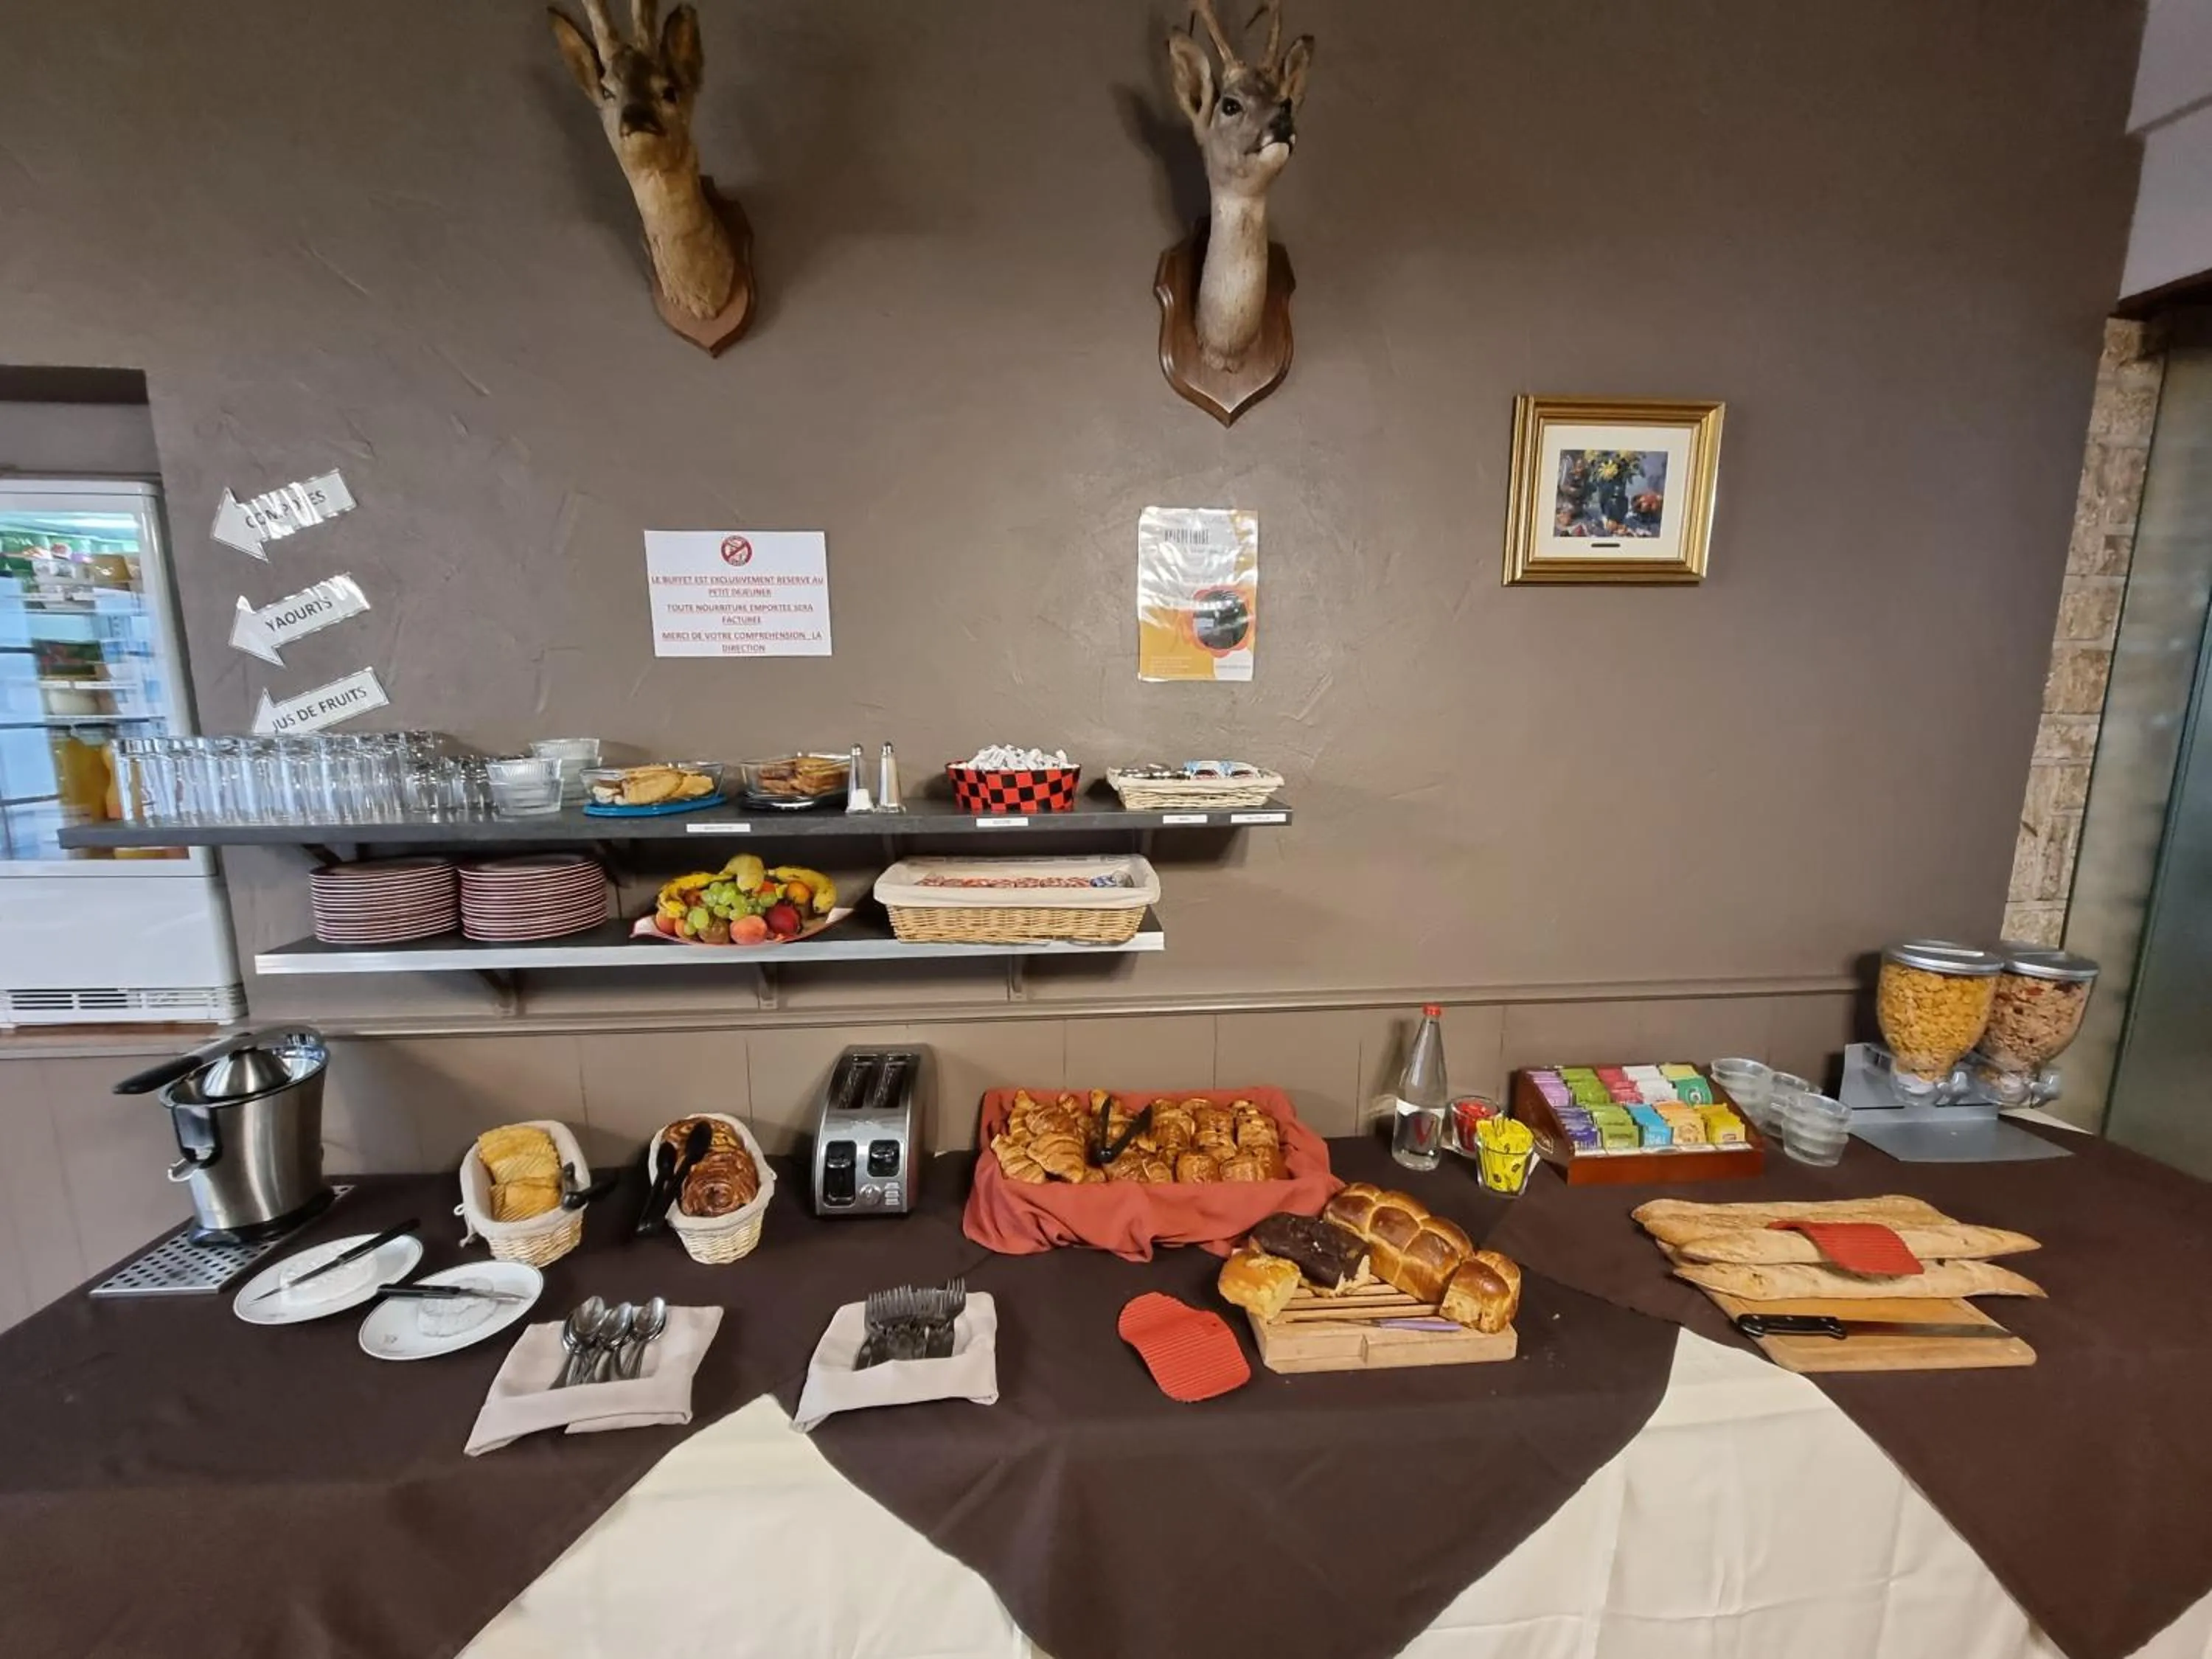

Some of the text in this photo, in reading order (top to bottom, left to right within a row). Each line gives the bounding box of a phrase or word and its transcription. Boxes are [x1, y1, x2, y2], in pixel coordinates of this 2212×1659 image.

[245, 490, 326, 529] COMPOES
[651, 576, 824, 585] LE BUFFET EST EXCLUSIVEMENT RESERVE AU
[709, 589, 729, 597] PETIT
[667, 604, 693, 613] TOUTE
[695, 604, 747, 613] NOURRITURE
[265, 597, 333, 632] YAOURTS
[662, 632, 689, 641] MERCI
[691, 632, 702, 640] DE
[704, 632, 731, 640] VOTRE
[812, 631, 821, 640] LA
[722, 644, 765, 653] DIRECTION
[271, 686, 367, 734] JUS DE FRUITS
